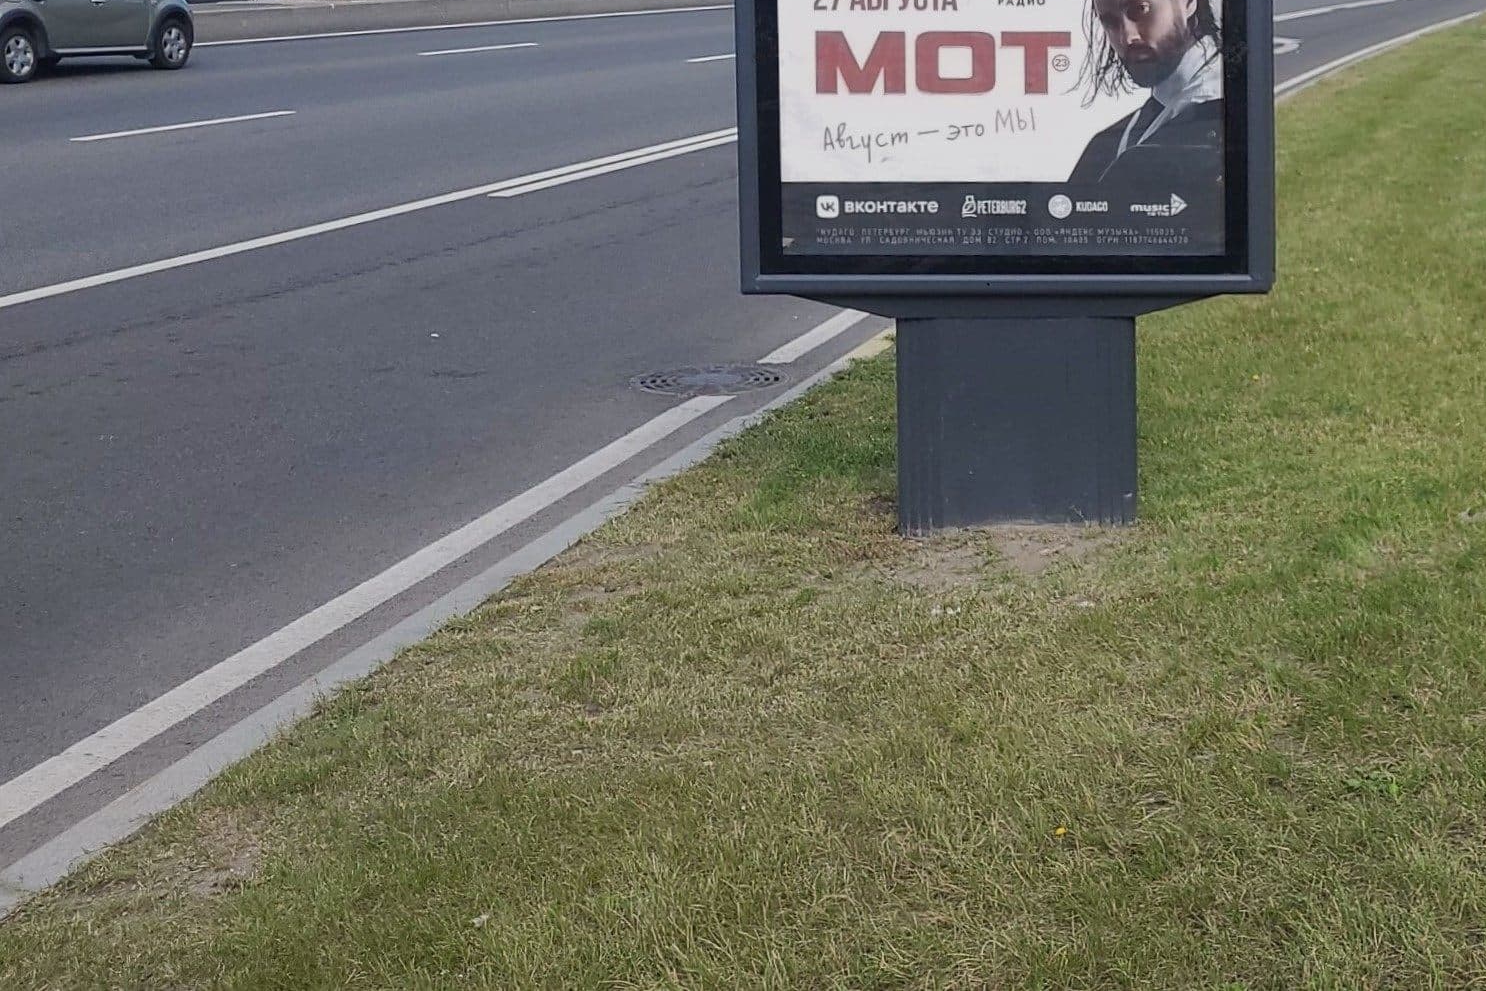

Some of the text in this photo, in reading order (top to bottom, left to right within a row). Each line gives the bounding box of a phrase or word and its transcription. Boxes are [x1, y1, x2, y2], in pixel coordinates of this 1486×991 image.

[815, 30, 1072, 95] МОТ
[1053, 56, 1069, 69] 23
[822, 122, 909, 163] Август
[945, 122, 986, 141] это
[994, 107, 1037, 134] МЫ
